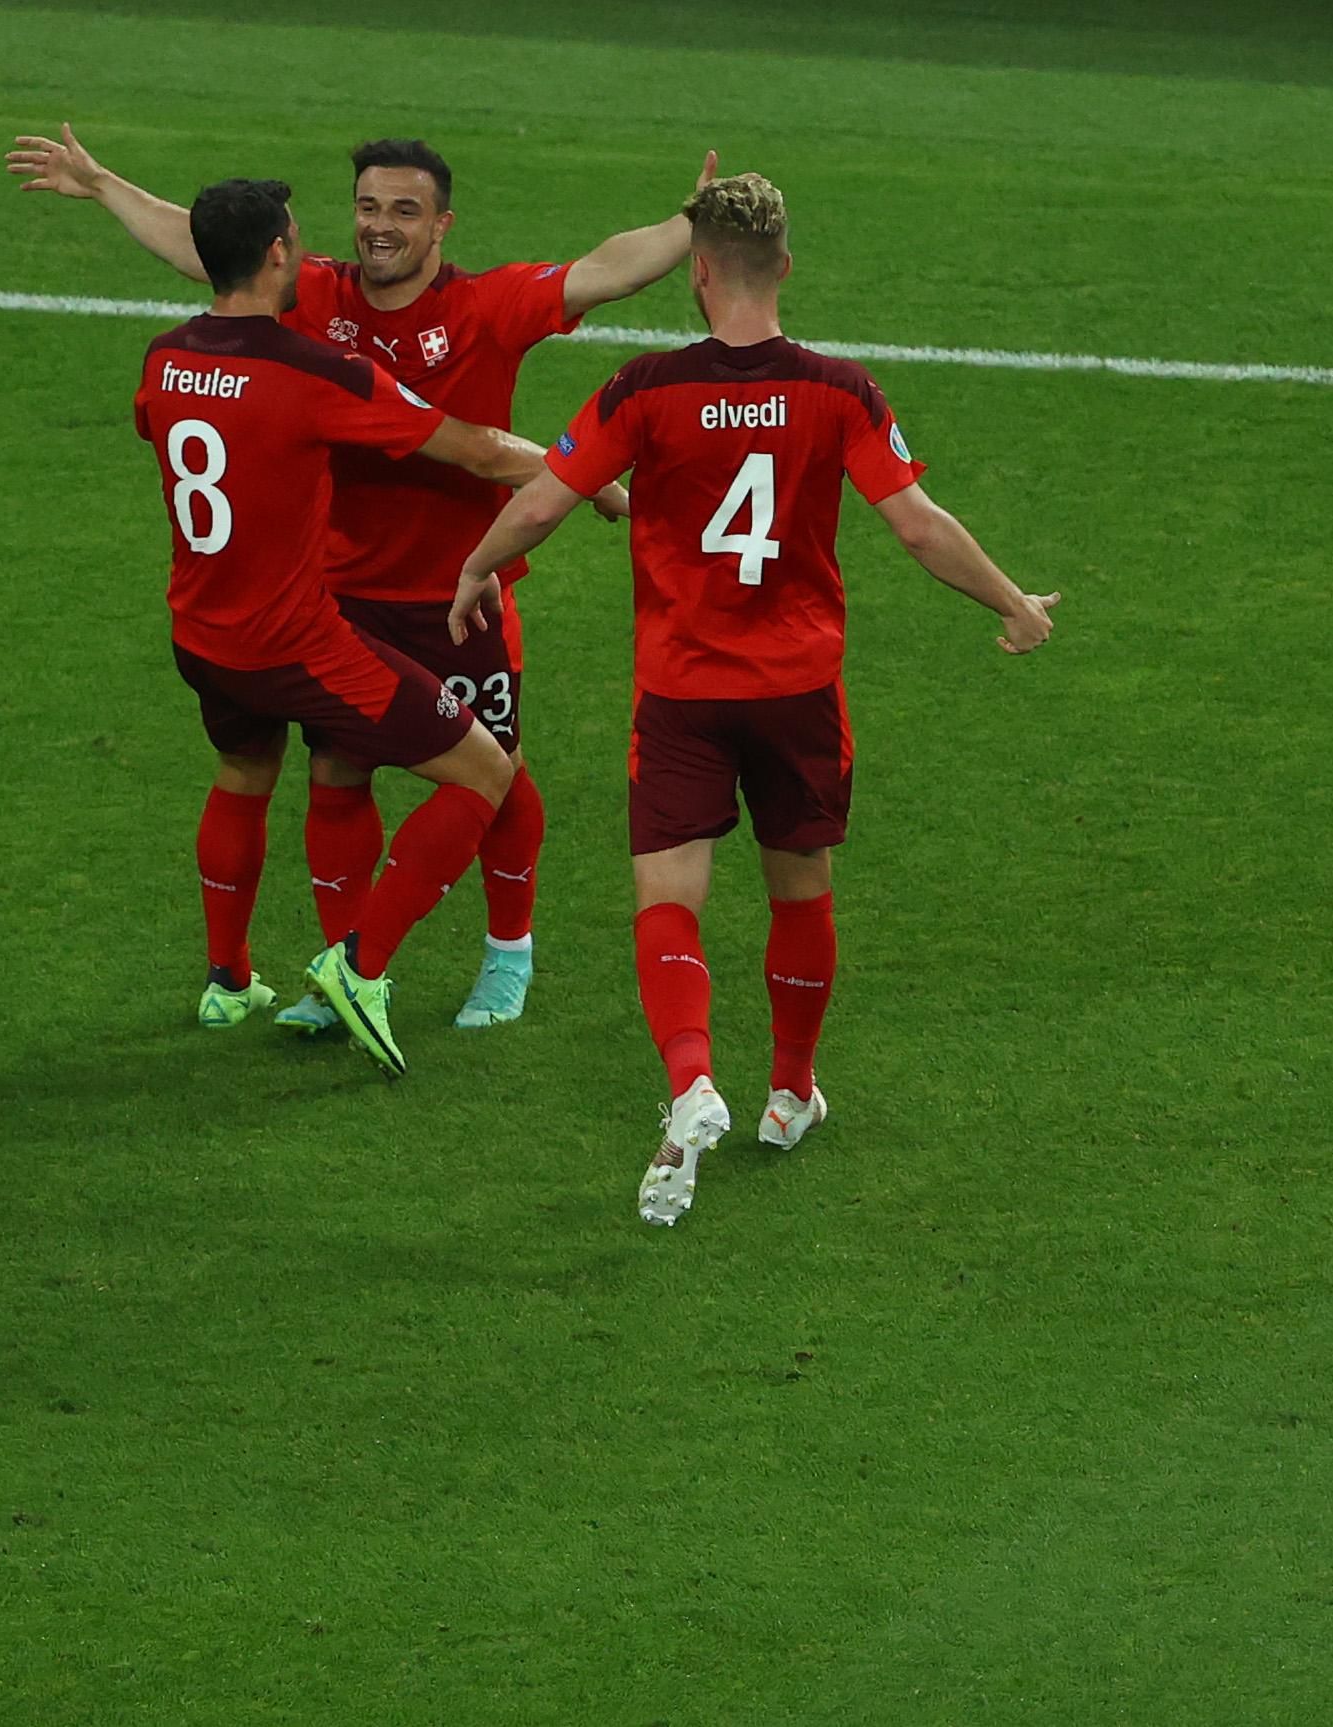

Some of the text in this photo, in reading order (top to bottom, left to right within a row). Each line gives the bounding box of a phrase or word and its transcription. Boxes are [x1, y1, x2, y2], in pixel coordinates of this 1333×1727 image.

[161, 360, 250, 399] freuler
[700, 395, 786, 430] elvedi
[167, 419, 232, 555] 8
[701, 452, 780, 586] 4
